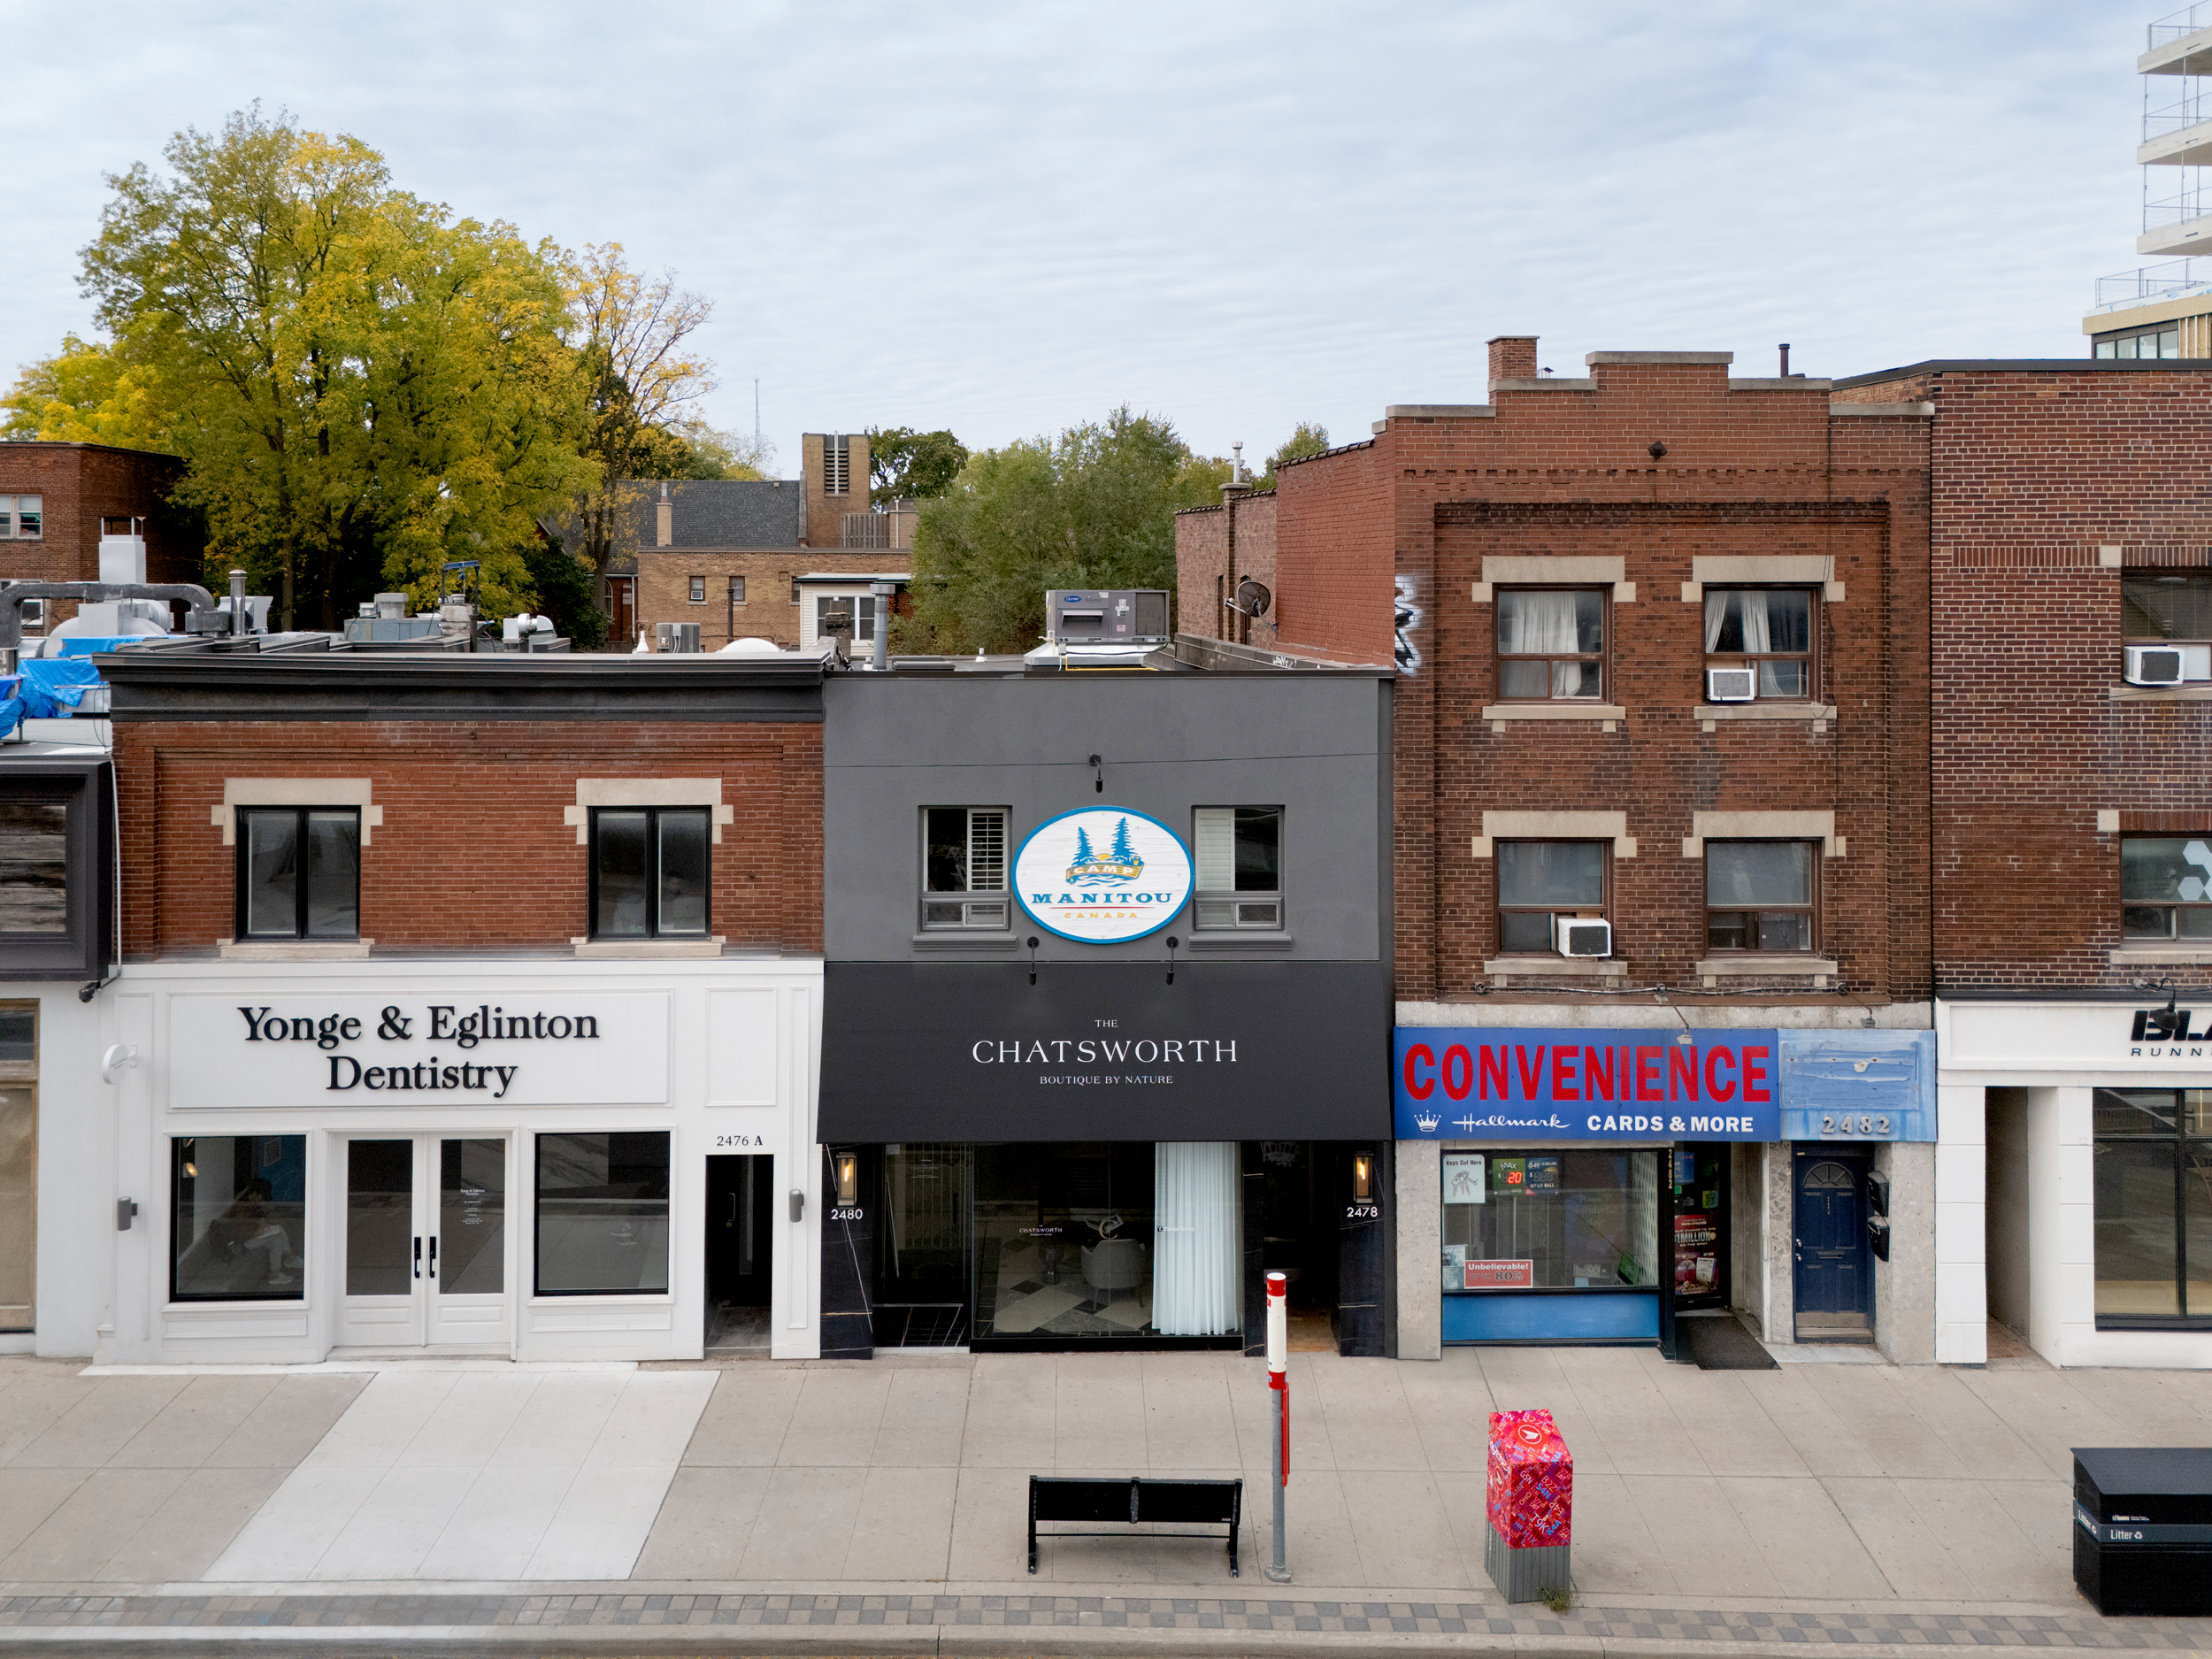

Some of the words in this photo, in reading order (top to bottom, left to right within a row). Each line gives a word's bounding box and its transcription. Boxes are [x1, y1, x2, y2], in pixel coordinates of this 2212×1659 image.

[1073, 864, 1133, 874] CAMP
[1031, 893, 1172, 903] MANITOU
[237, 1006, 362, 1050] Yonge
[377, 1005, 412, 1041] &
[426, 1005, 600, 1048] Eglinton
[2131, 1010, 2212, 1041] BL
[972, 1040, 1238, 1064] CHATSWORTH
[2131, 1048, 2212, 1056] RUNN
[326, 1056, 518, 1098] Dentistry
[1040, 1076, 1101, 1086] BOUTIQUE
[1125, 1075, 1173, 1084] NATURE
[1403, 1043, 1770, 1102] CONVENIENCE
[1452, 1113, 1571, 1133] Hallmark
[1587, 1115, 1663, 1132] CARDS
[1669, 1116, 1686, 1132] &
[1690, 1116, 1754, 1133] MORE
[1822, 1117, 1890, 1133] 2482
[717, 1136, 749, 1146] 2476
[754, 1135, 764, 1146] A
[1507, 1171, 1523, 1185] 20
[831, 1209, 863, 1220] 2480
[1347, 1206, 1379, 1217] 2478
[1494, 1271, 1513, 1281] 80
[1519, 1470, 1534, 1485] G5N
[1541, 1475, 1558, 1493] B2Z
[1536, 1483, 1551, 1500] S4N
[1531, 1511, 1549, 1534] T9K
[1547, 1519, 1562, 1536] K4A
[2078, 1509, 2091, 1530] Litter
[1522, 1529, 1538, 1545] H1X
[2110, 1529, 2132, 1540] Litter
